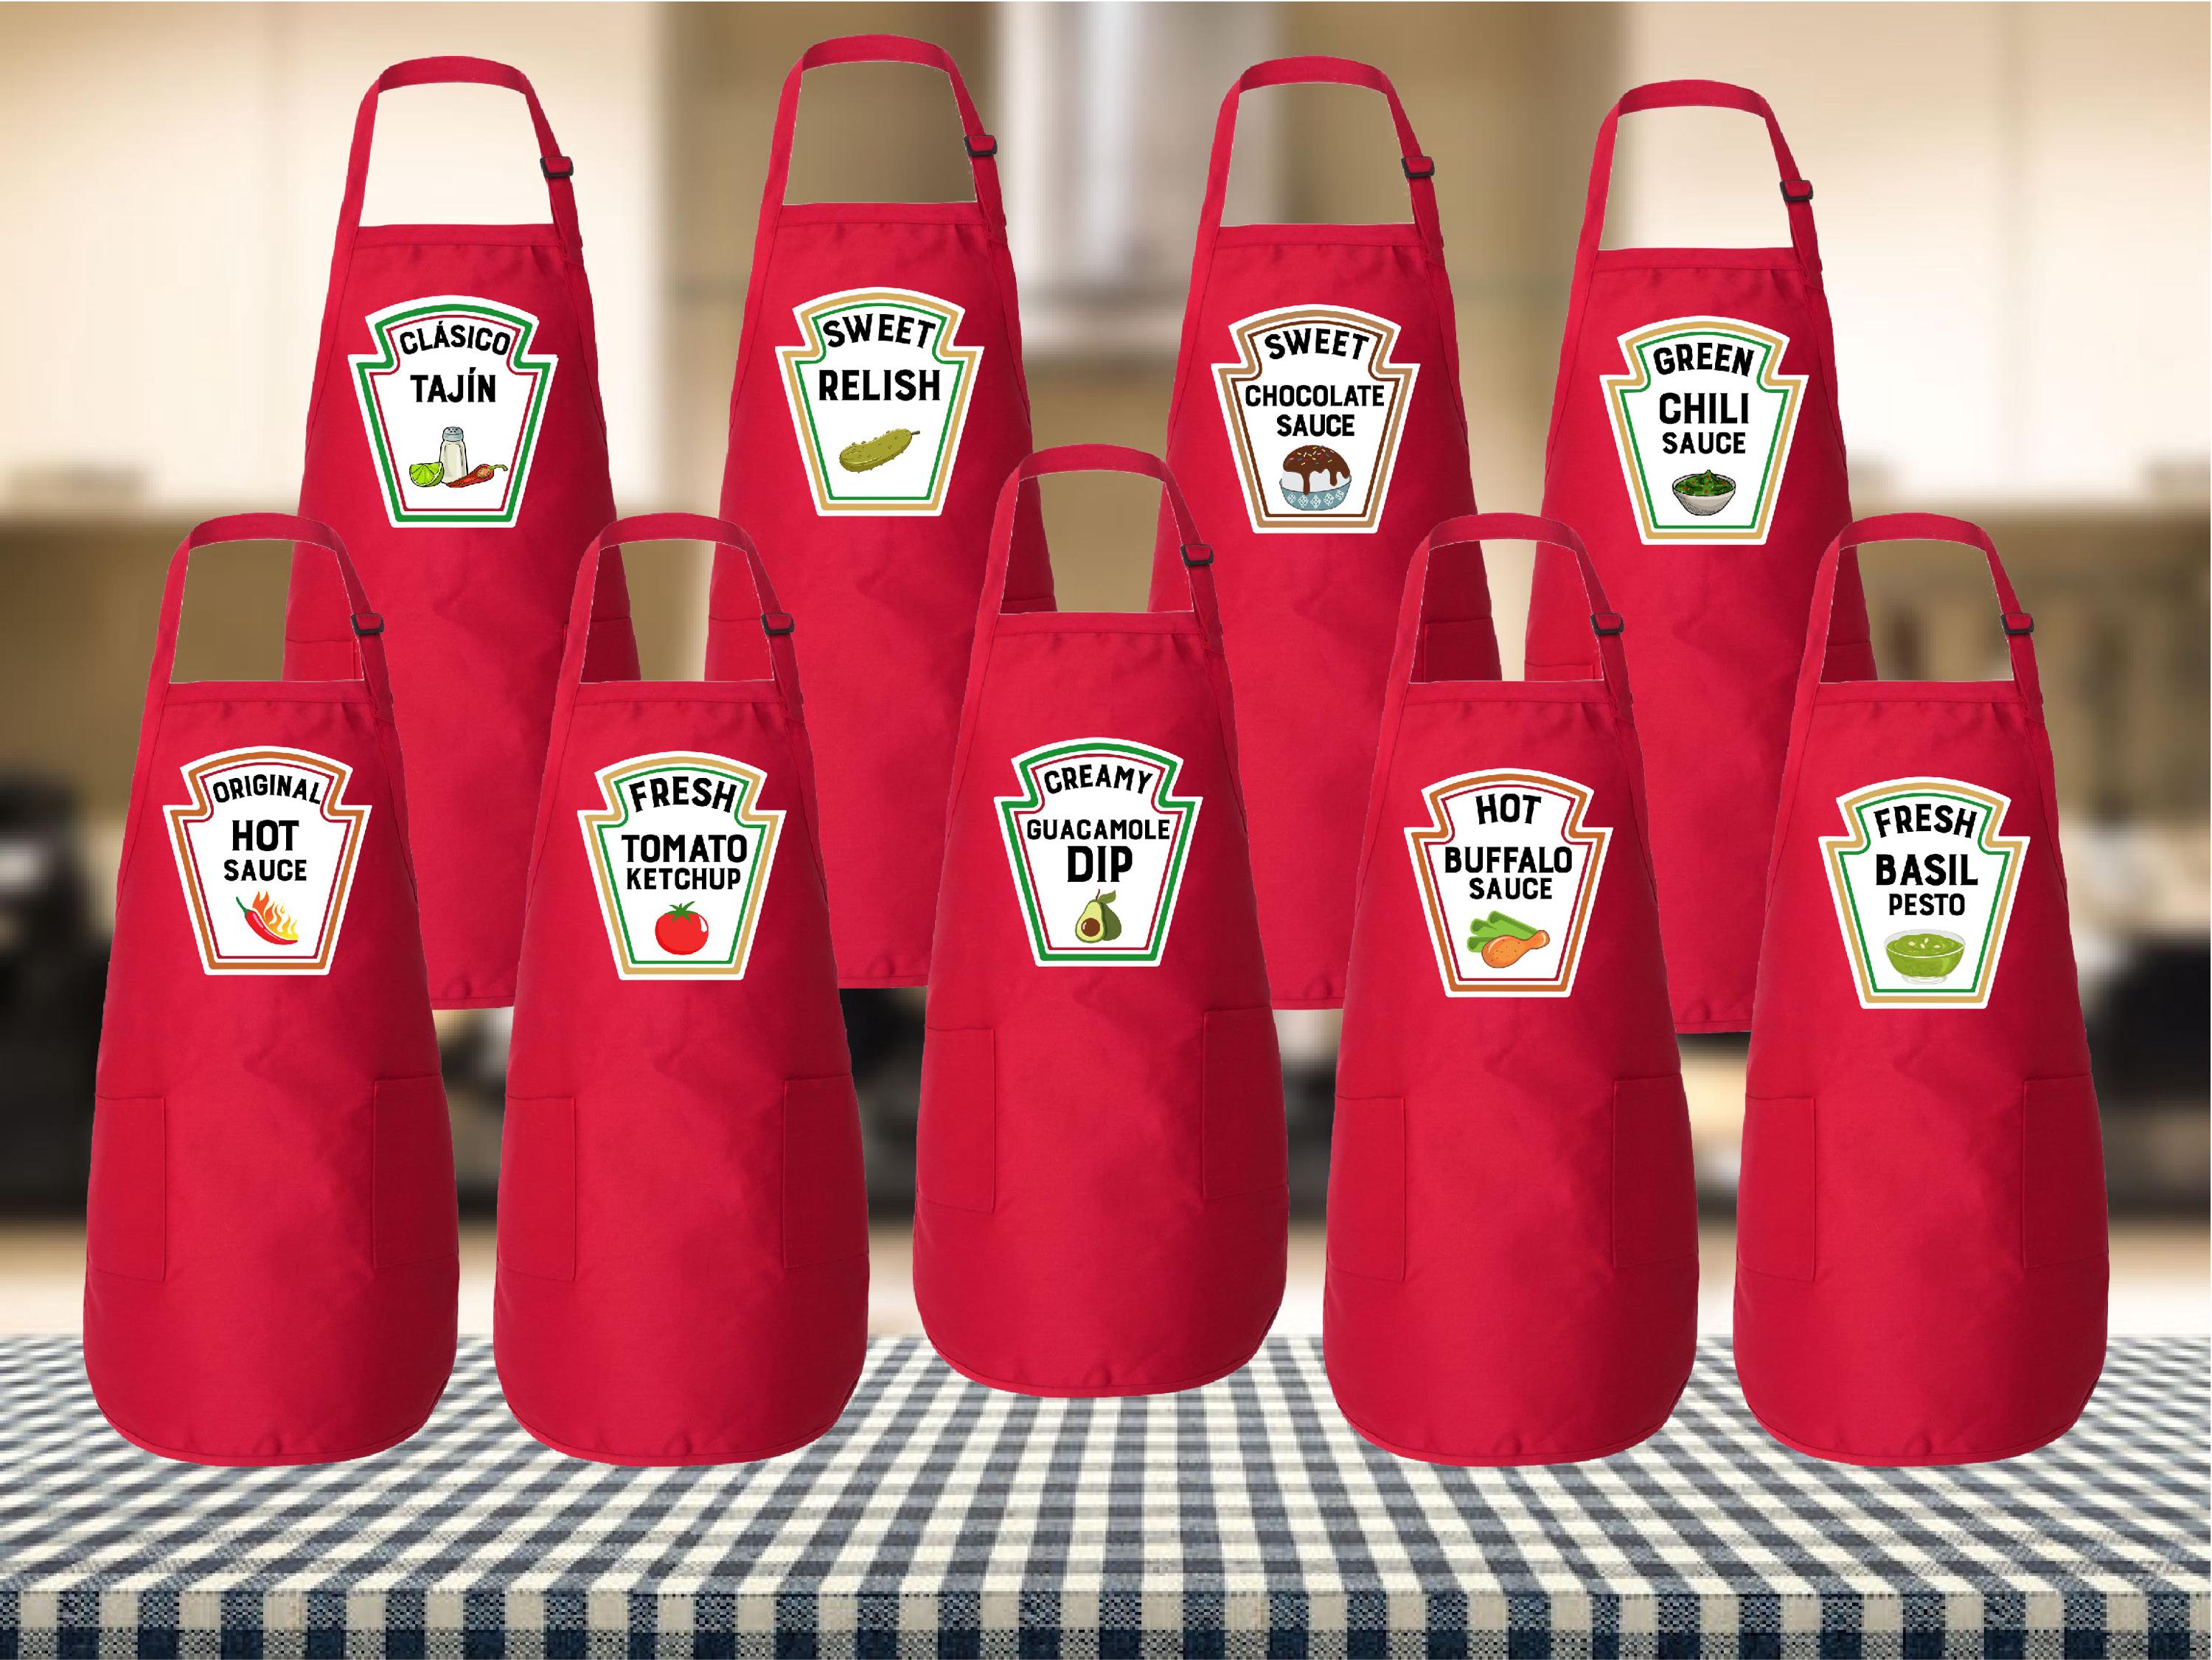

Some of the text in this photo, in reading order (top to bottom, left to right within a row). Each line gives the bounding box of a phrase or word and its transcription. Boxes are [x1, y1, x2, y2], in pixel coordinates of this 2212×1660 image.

[400, 320, 511, 355] CLÁSICO
[822, 313, 936, 349] SWEET
[1264, 327, 1370, 361] SWEET
[1653, 342, 1755, 377] GREEN
[410, 367, 496, 403] TAJÍN
[818, 369, 941, 401] RELISH
[1245, 384, 1385, 407] CHOCOLATE
[1659, 392, 1749, 425] CHILI
[1276, 414, 1355, 437] SAUCE
[1662, 431, 1746, 454] SAUCE
[212, 774, 321, 805] ORIGINAL
[628, 776, 737, 813] FRESH
[1043, 764, 1153, 794] CREAMY
[1475, 793, 1542, 825] HOT
[1873, 803, 1978, 839] FRESH
[232, 819, 299, 852] HOT
[1026, 819, 1170, 840] GUACAMOLE
[621, 834, 748, 864] TOMATO
[1067, 845, 1133, 883] DIP
[1444, 846, 1573, 873] BUFFALO
[223, 858, 307, 882] SAUCE
[627, 867, 741, 890] KETCHUP
[1876, 853, 1978, 886] BASIL
[1469, 877, 1552, 900] SAUCE
[1889, 893, 1965, 916] PESTO
